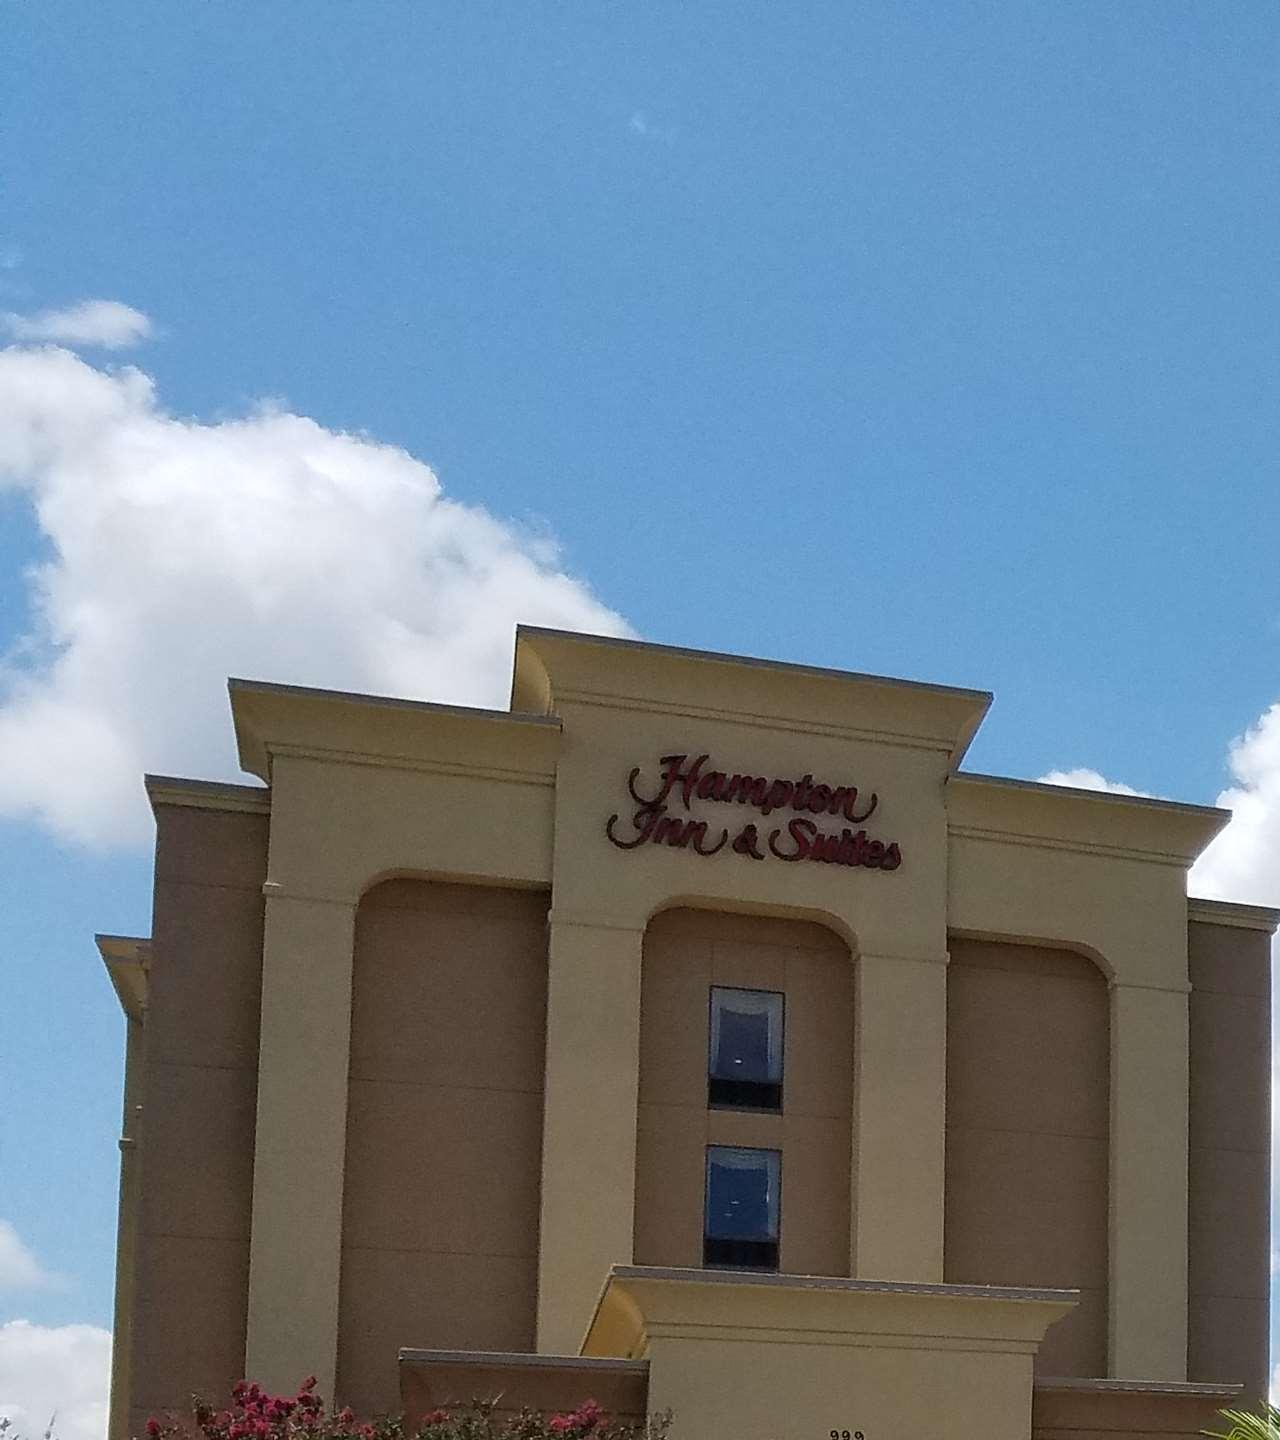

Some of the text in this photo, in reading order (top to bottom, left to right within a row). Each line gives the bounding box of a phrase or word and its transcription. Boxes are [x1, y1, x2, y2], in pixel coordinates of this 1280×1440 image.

[628, 754, 878, 823] Hampton
[606, 802, 902, 871] Inn & Suites
